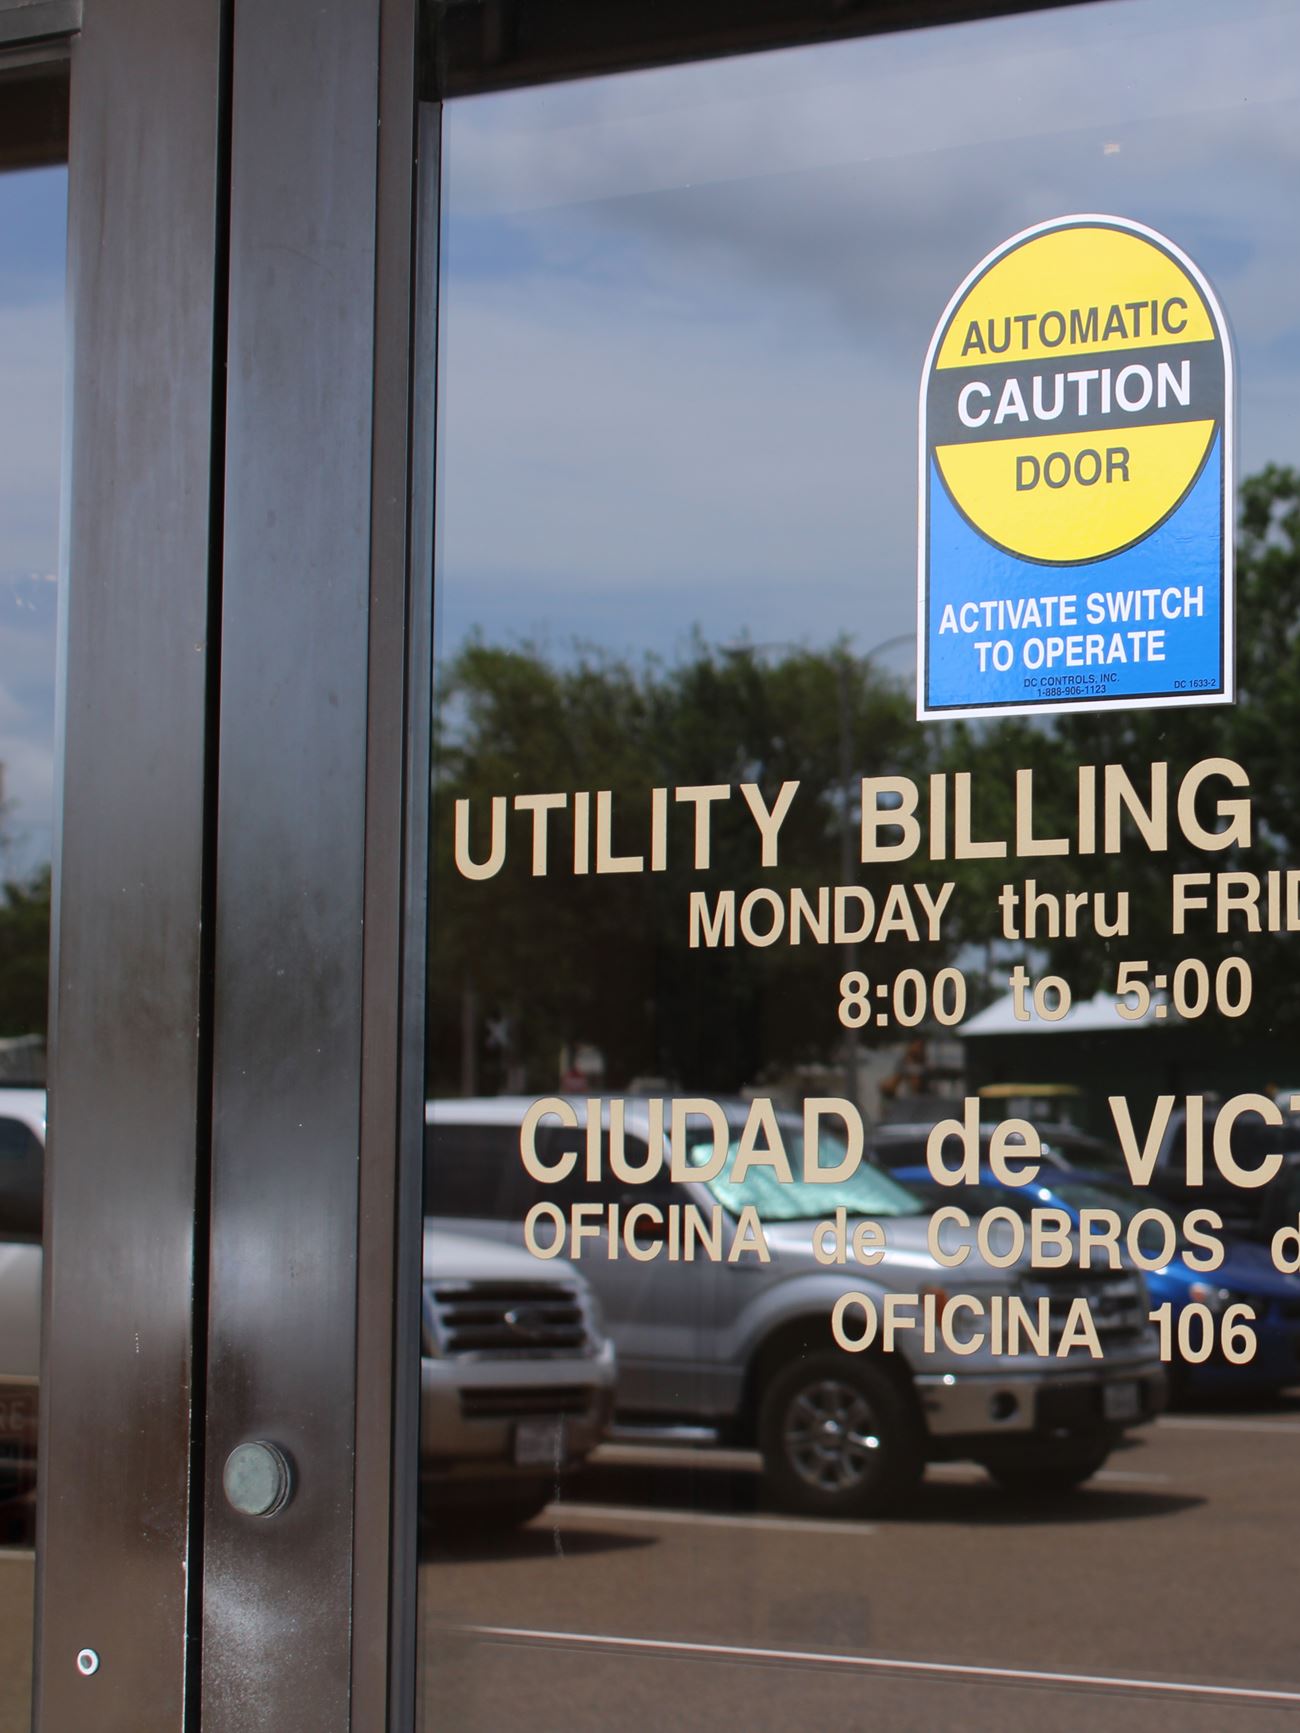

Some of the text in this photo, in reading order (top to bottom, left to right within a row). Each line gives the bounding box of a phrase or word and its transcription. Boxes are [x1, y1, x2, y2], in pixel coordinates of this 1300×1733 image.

[960, 296, 1189, 357] AUTOMATIC
[957, 360, 1191, 428] CAUTION
[1015, 446, 1131, 492] DOOR
[938, 585, 1204, 635] ACTIVATE SWITCH
[974, 629, 1167, 673] TO OPERATE
[1023, 678, 1038, 688] DC
[1100, 672, 1120, 683] INC.
[1037, 684, 1107, 698] 1-888-906-1123
[1174, 678, 1216, 689] DC 1633-2
[455, 781, 799, 882] UTILITY
[860, 757, 1251, 864] BILLING
[689, 883, 953, 949] MONDAY
[998, 879, 1128, 940] thru
[838, 956, 1252, 1029] 8:00 to 5:00
[519, 1097, 864, 1185] CIUDAD
[926, 1097, 1042, 1187] de
[523, 1202, 770, 1263] OFICINA
[813, 1207, 885, 1266] de
[927, 1208, 1224, 1272] COBROS
[831, 1293, 1257, 1365] OFICINA 106
